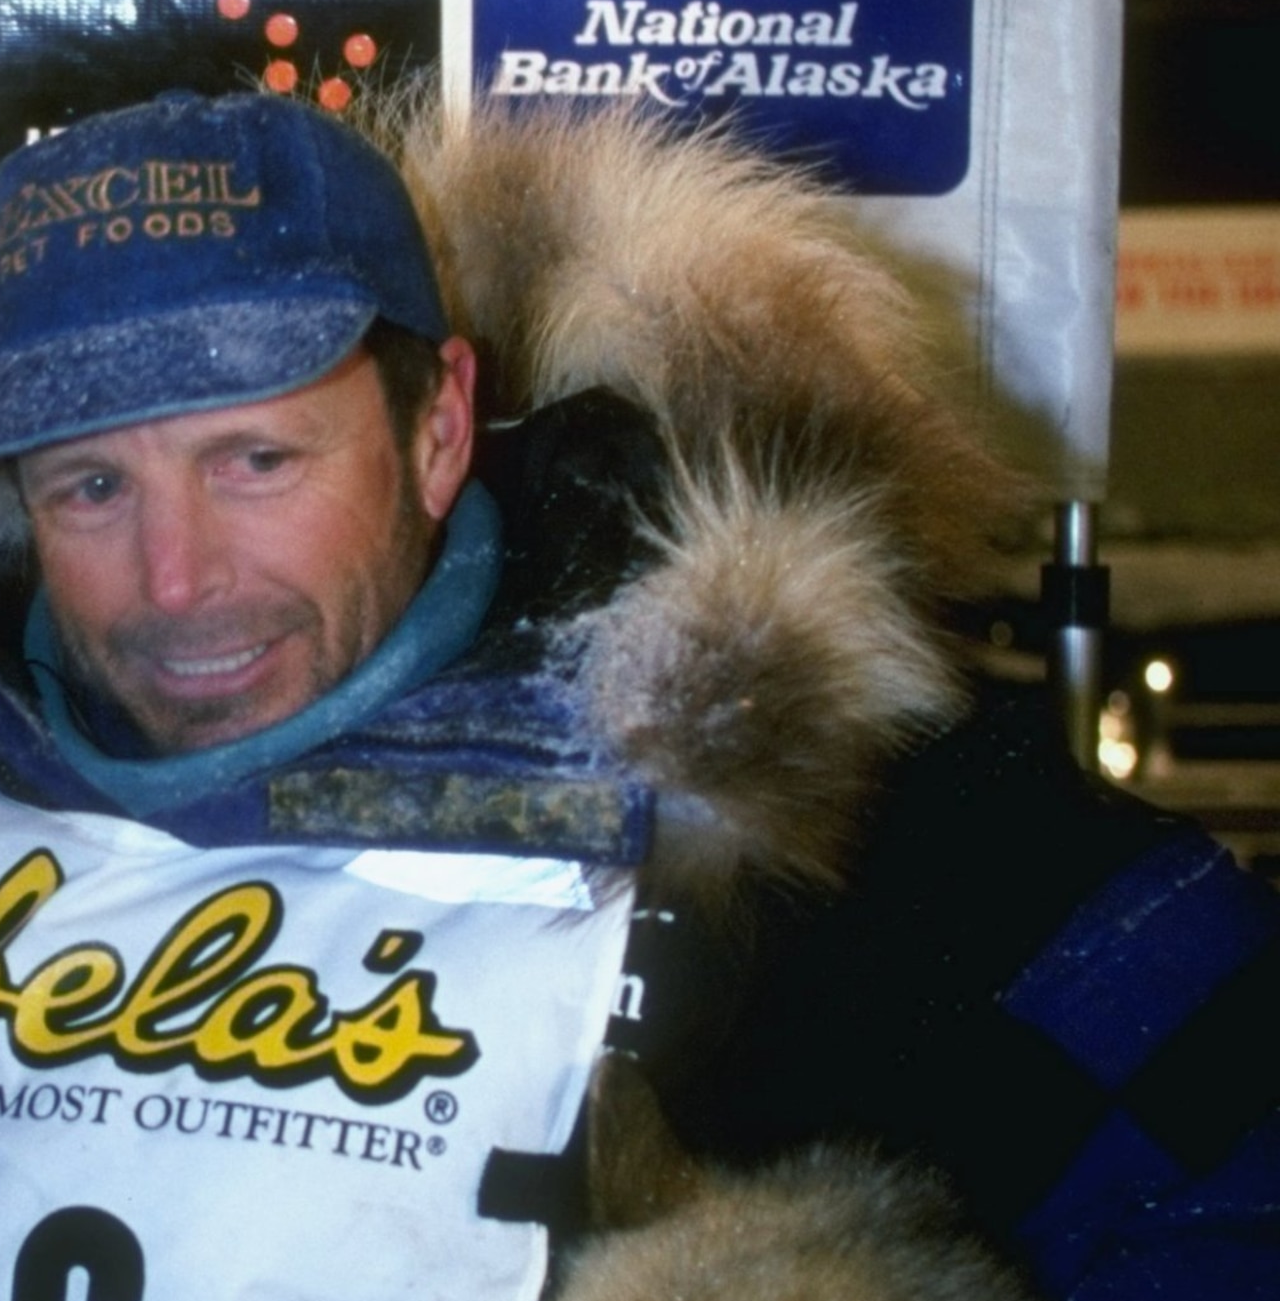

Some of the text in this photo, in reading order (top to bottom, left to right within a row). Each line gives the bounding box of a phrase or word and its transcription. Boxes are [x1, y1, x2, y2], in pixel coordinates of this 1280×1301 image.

[574, 0, 859, 46] National
[493, 51, 948, 110] Bank of Alaska
[76, 210, 237, 247] FOODS
